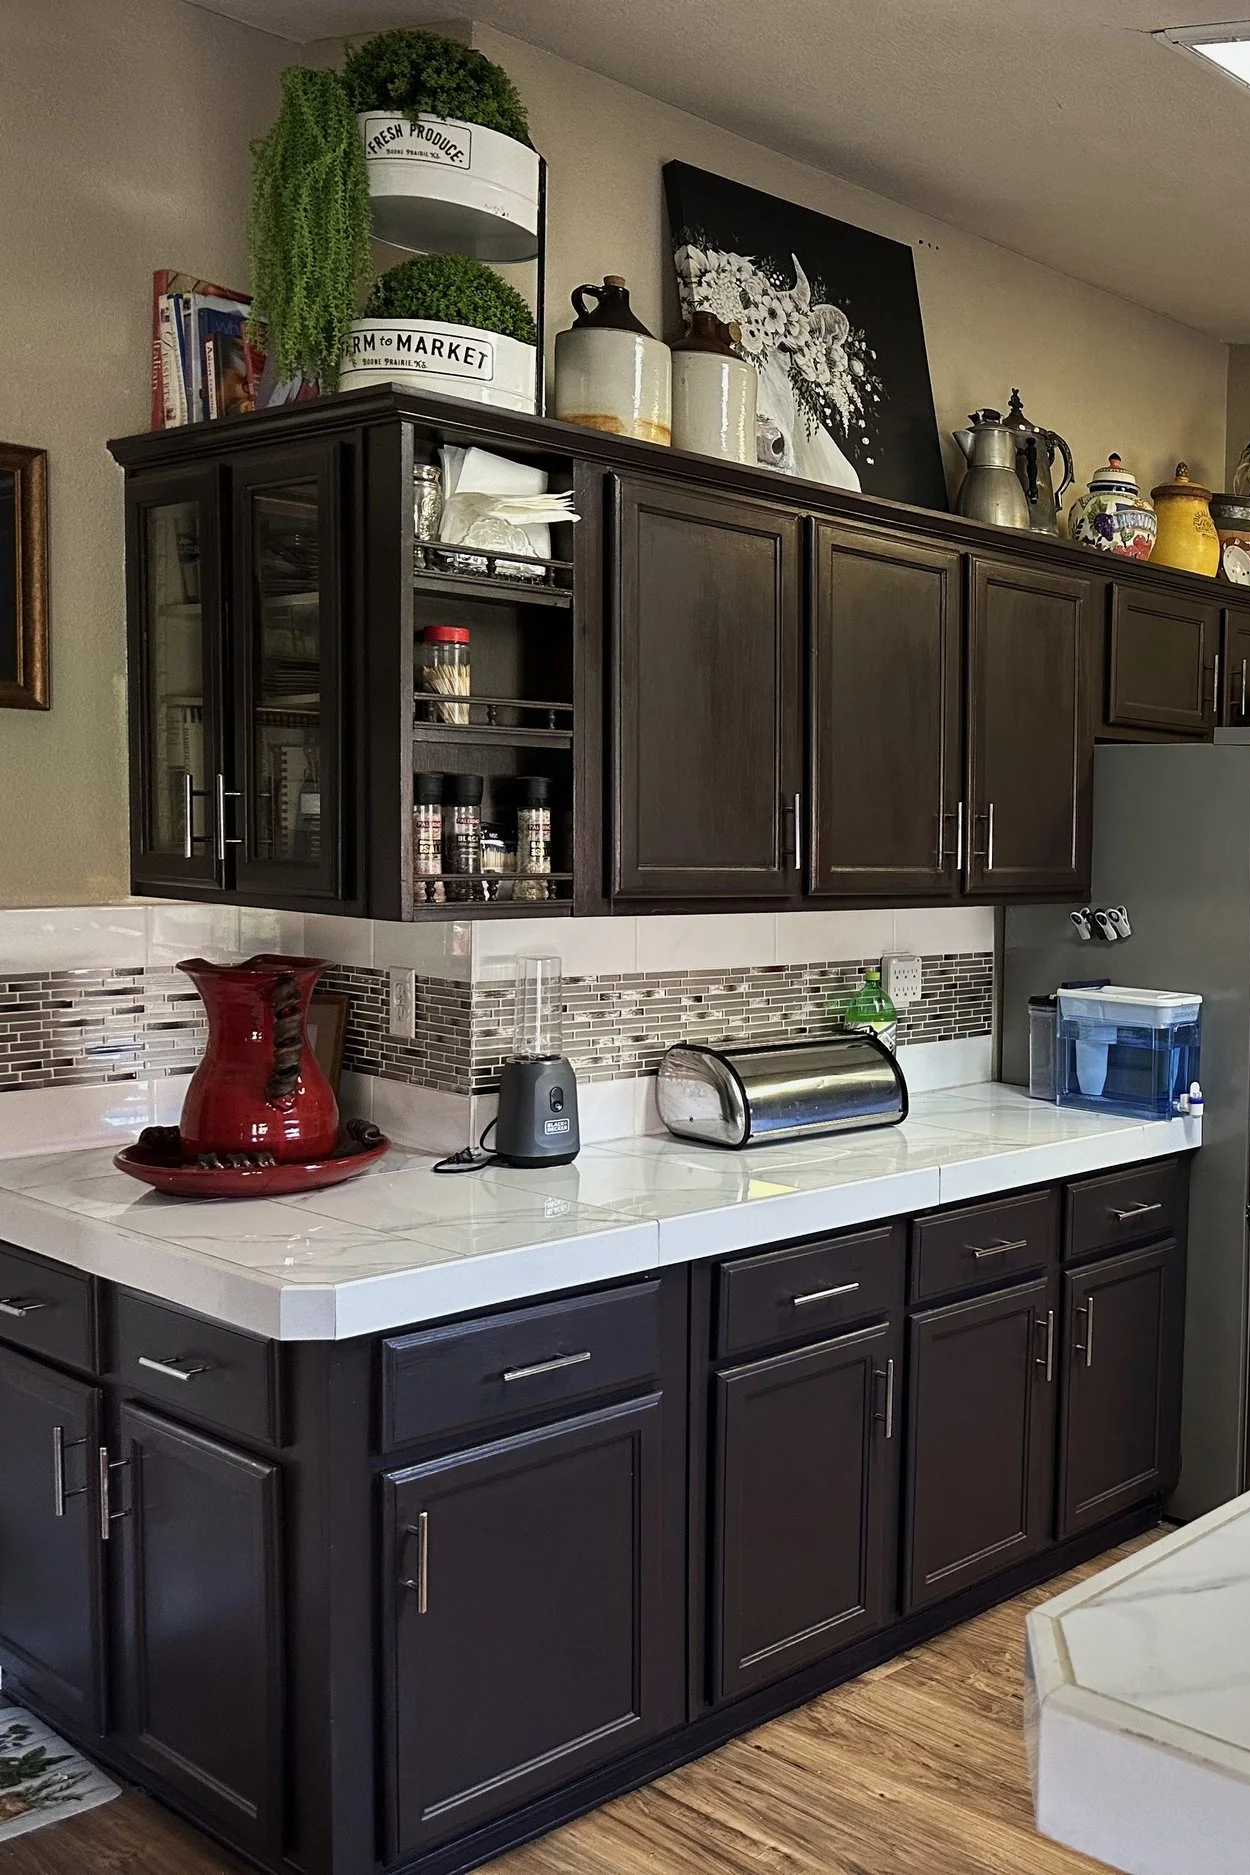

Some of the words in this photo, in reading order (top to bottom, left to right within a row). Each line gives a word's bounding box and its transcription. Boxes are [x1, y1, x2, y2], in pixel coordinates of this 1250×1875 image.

[368, 124, 403, 154] FRESH
[409, 123, 463, 162] PRODUCE
[153, 340, 161, 390] Italian
[380, 336, 393, 346] to
[397, 333, 489, 369] MARKET
